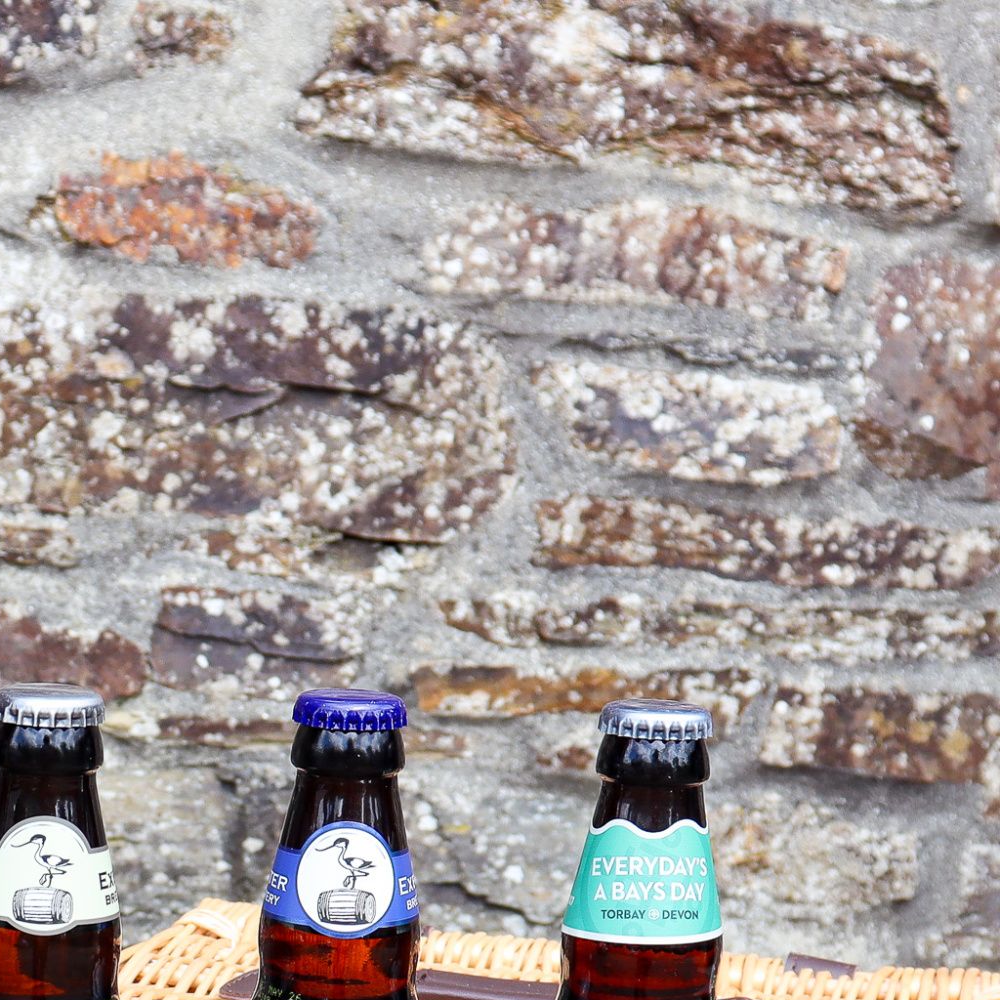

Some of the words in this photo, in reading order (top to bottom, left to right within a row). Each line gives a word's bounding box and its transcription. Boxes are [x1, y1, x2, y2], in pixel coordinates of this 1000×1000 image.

[592, 857, 708, 876] EVERYDAY'S
[594, 882, 607, 901] A
[612, 881, 665, 901] BAYS
[670, 882, 705, 901] DAY
[601, 909, 646, 920] TORBAY
[662, 909, 699, 920] DEVON
